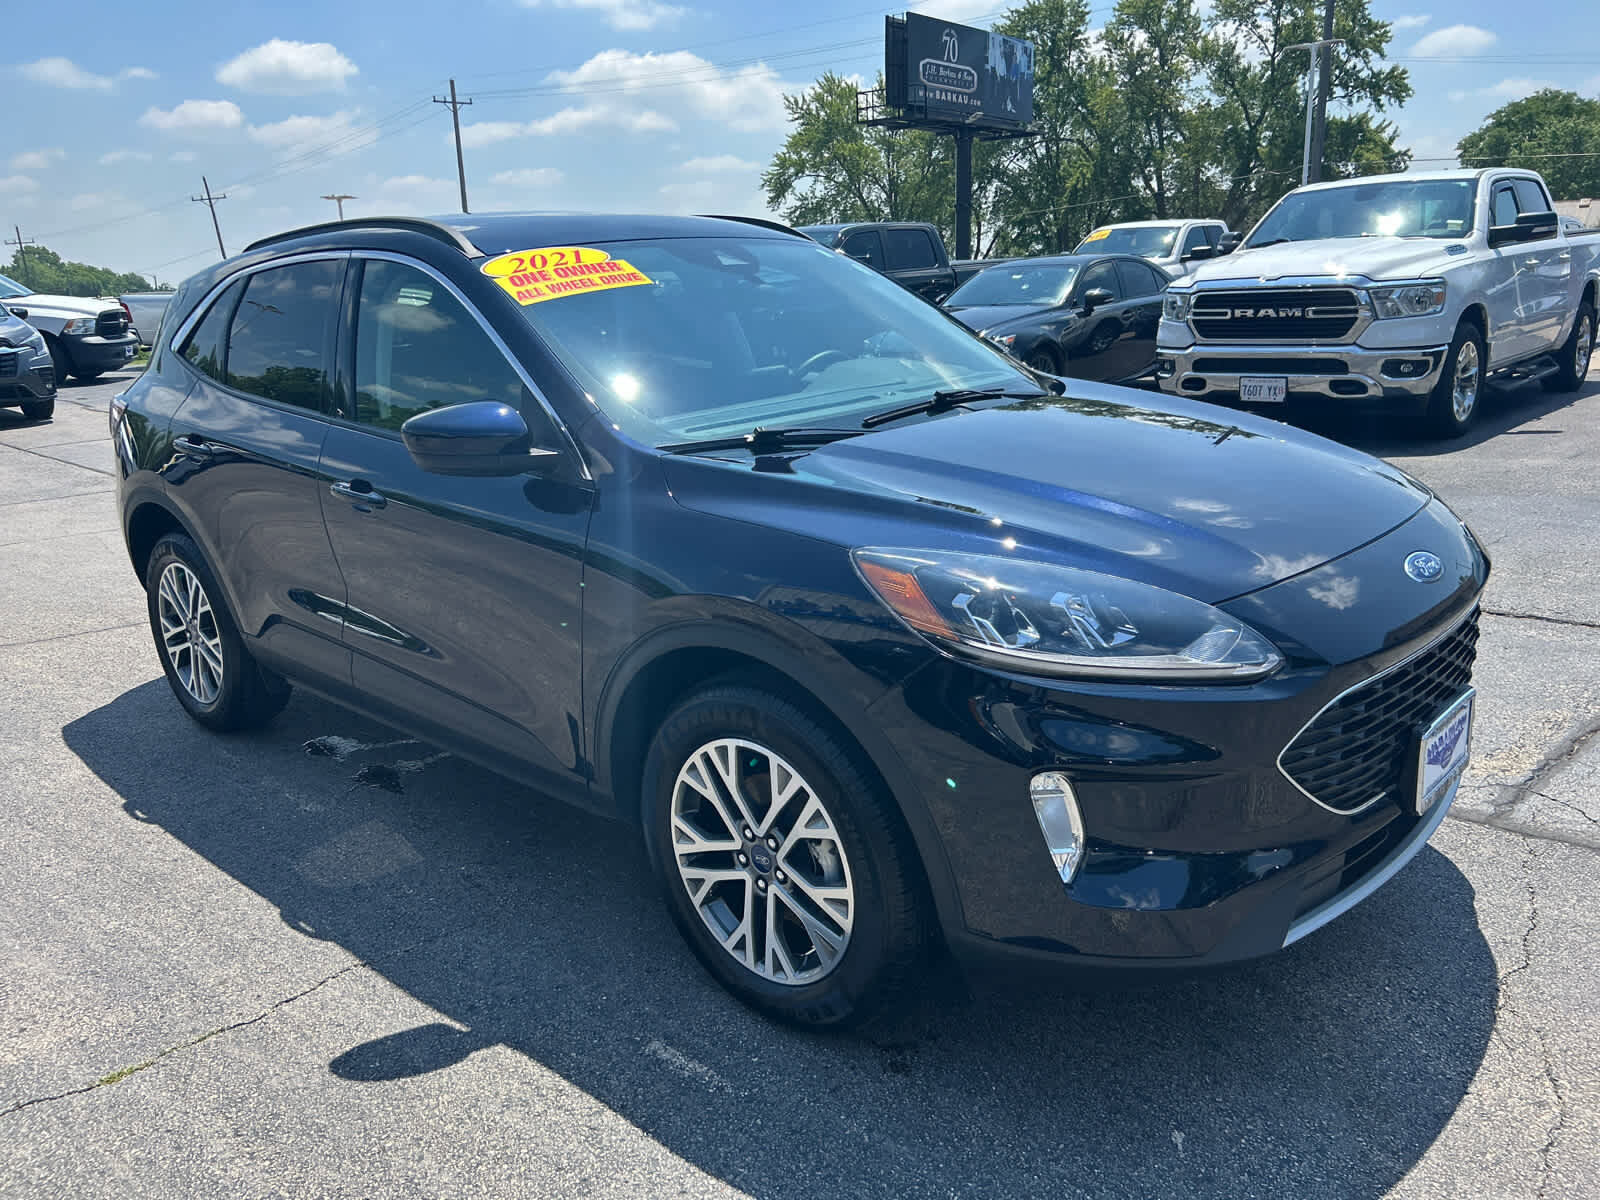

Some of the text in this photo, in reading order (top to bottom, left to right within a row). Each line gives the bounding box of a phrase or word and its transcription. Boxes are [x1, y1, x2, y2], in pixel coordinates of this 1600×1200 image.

[943, 36, 958, 63] 70
[508, 249, 585, 274] 2021
[509, 261, 623, 287] ONE OWNER
[516, 271, 642, 301] ALL WHEEL DRIVE
[1234, 308, 1302, 318] RAM
[1242, 384, 1262, 398] 7607
